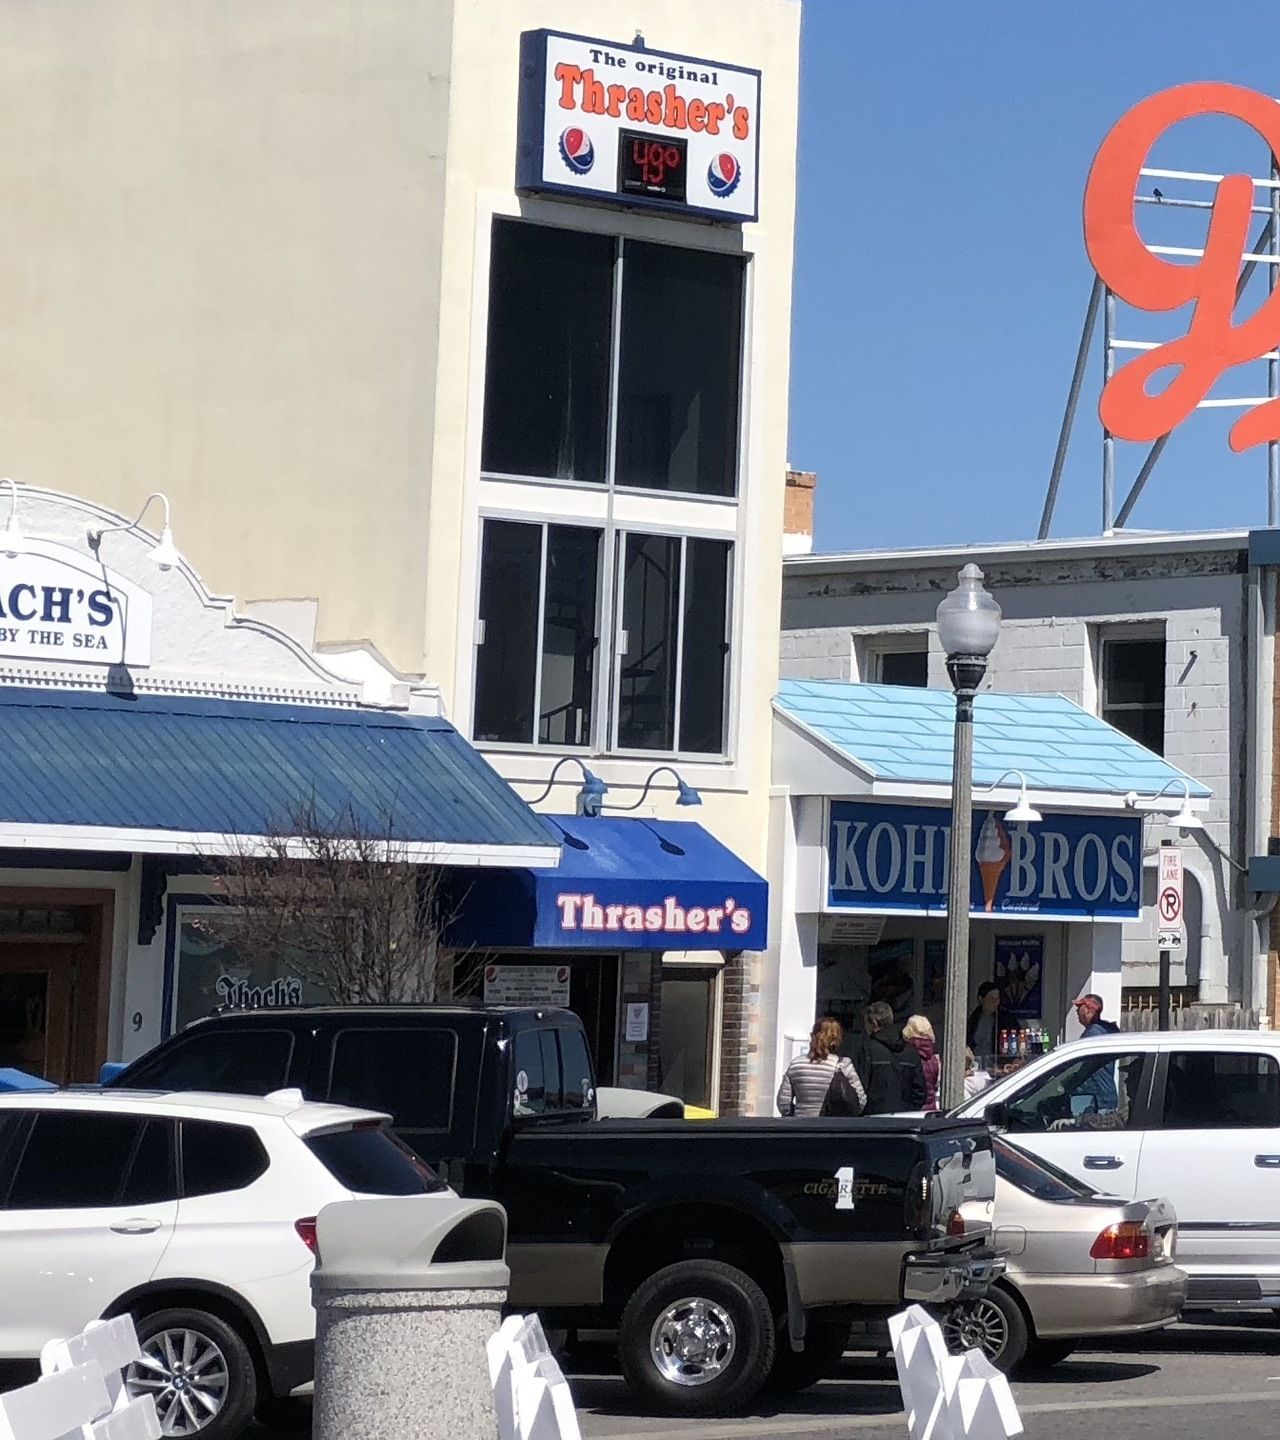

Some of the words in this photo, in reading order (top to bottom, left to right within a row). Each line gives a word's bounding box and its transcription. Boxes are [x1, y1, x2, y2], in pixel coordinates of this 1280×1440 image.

[590, 49, 626, 68] The
[635, 61, 718, 86] original
[555, 62, 749, 140] Thrasher's
[0, 583, 114, 627] CH'S
[28, 629, 64, 646] THE
[73, 633, 108, 649] SEA
[830, 820, 950, 895] KOH
[1162, 868, 1179, 881] LANE
[1163, 855, 1178, 867] FIRE
[557, 892, 751, 933] Thrasher's
[132, 1012, 143, 1032] 9
